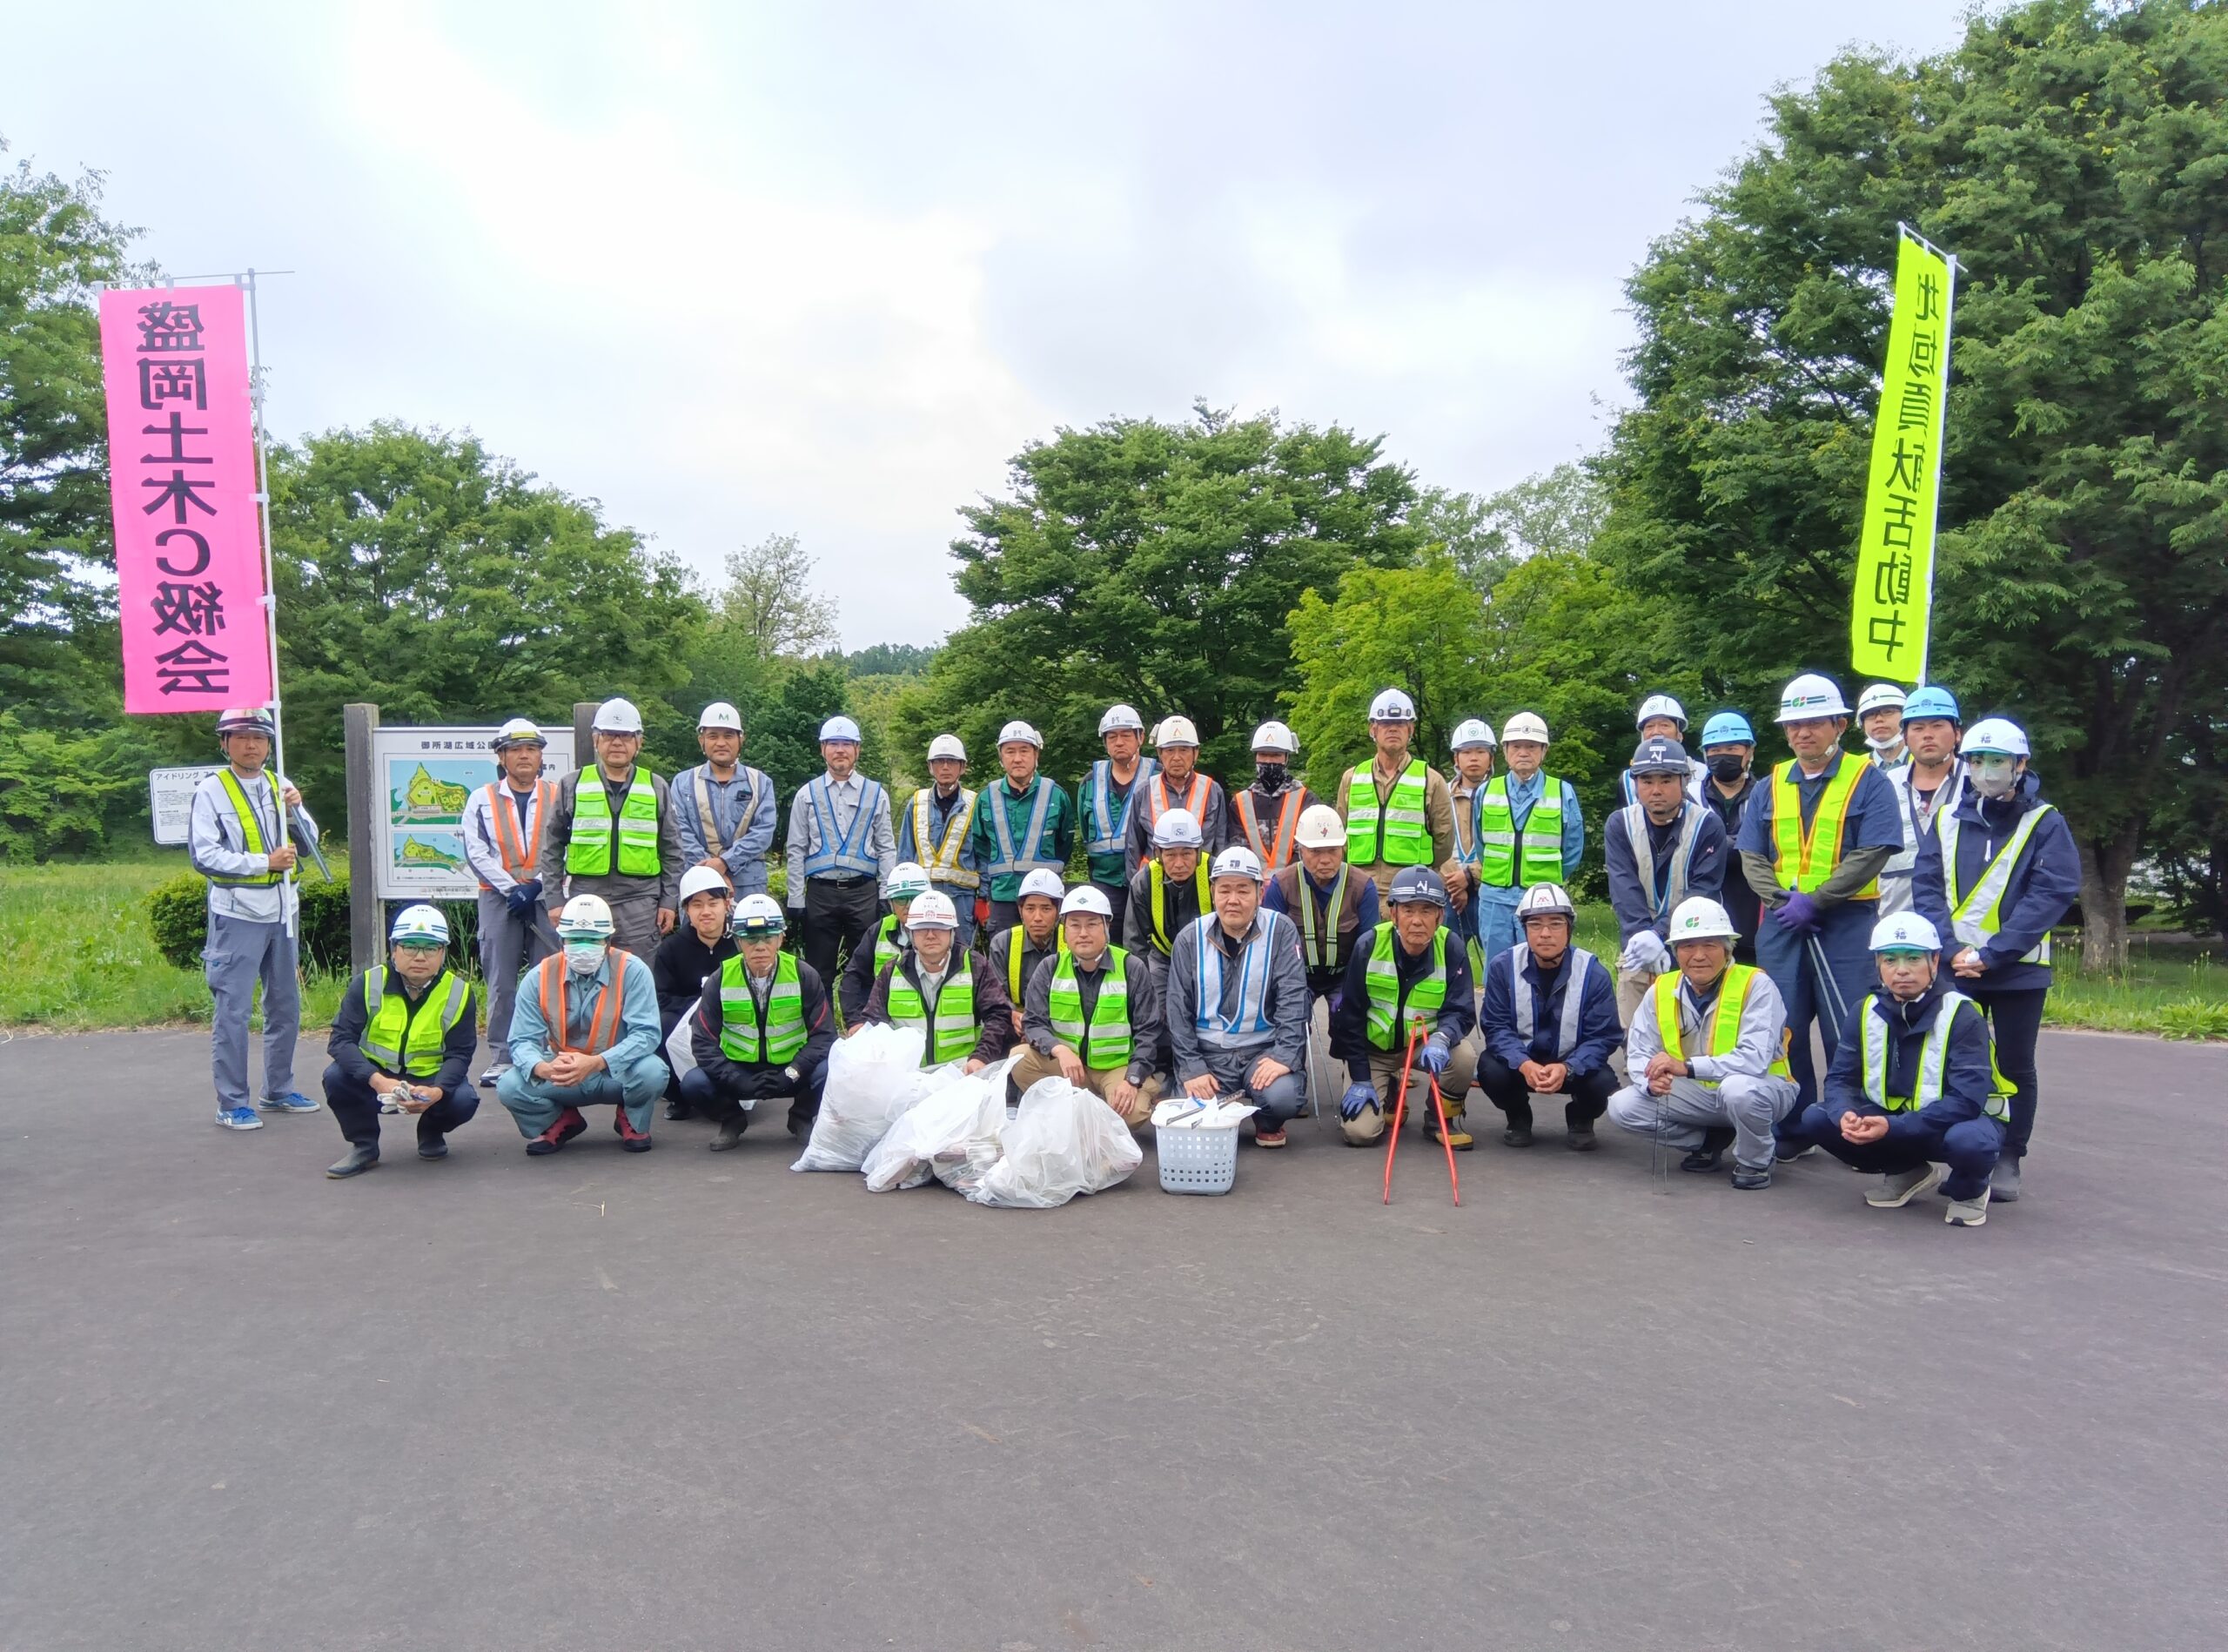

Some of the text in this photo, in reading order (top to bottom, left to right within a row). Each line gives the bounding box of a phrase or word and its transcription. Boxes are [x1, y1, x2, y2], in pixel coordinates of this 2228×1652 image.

[156, 771, 199, 781] アイドリング
